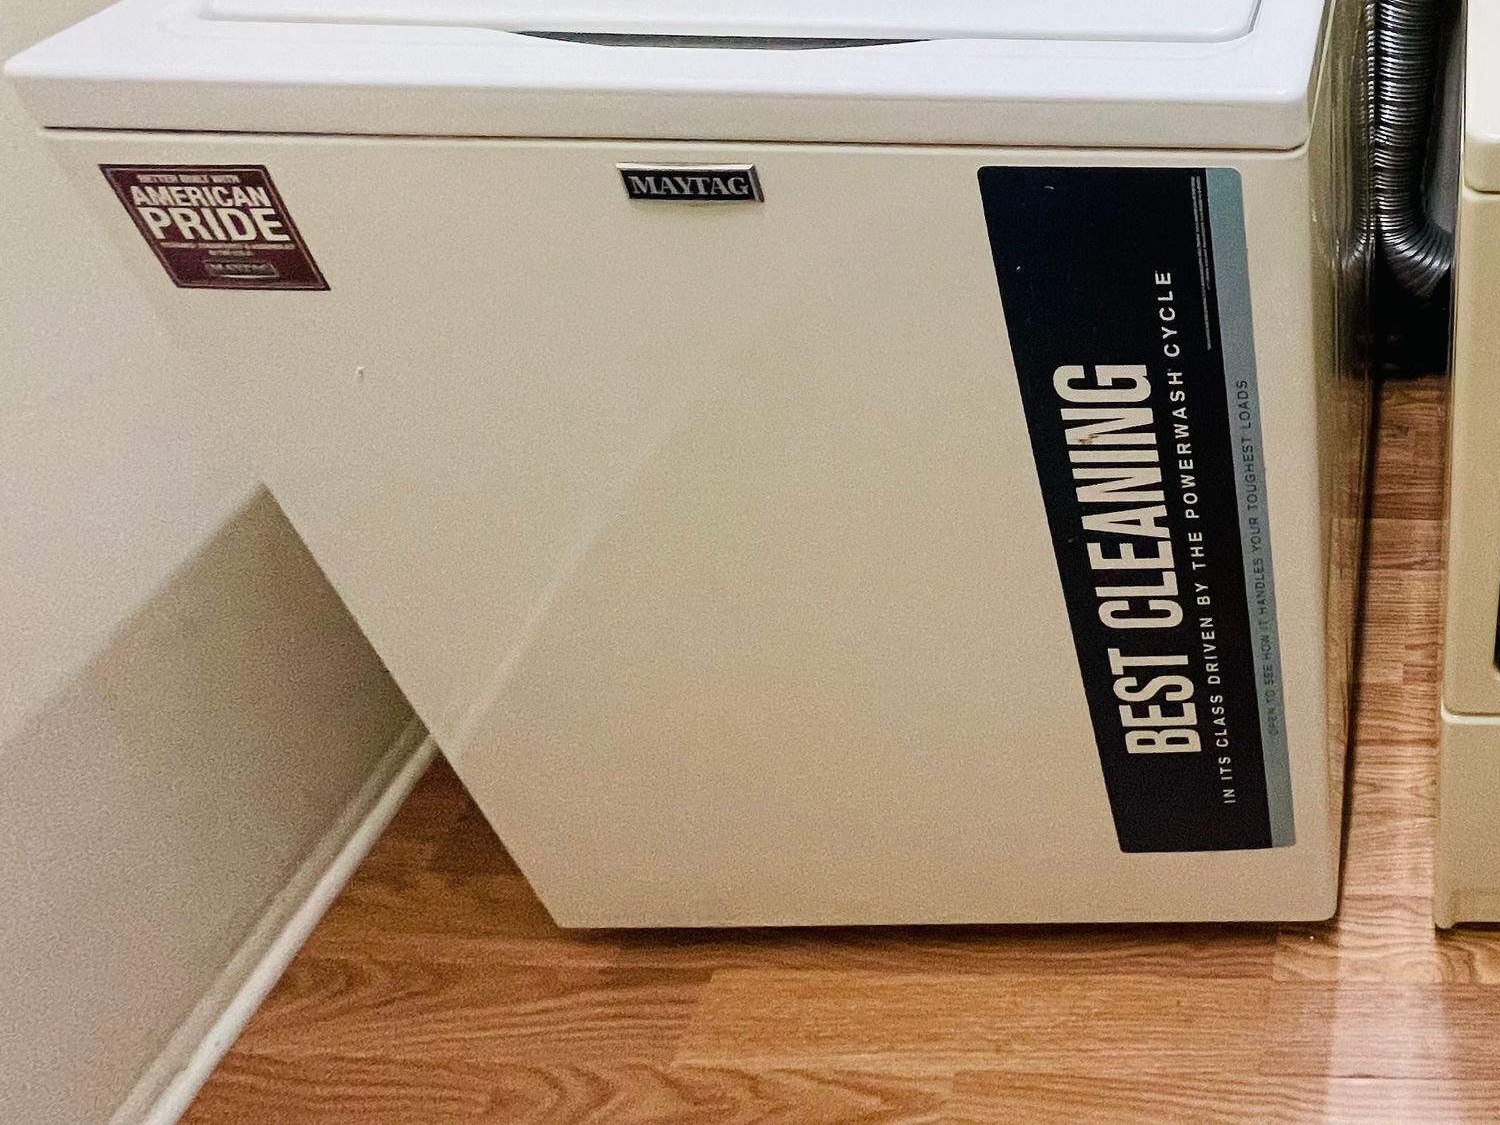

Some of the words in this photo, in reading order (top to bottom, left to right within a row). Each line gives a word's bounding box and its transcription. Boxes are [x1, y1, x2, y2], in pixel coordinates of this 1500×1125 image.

[130, 185, 272, 207] AMERICAN
[627, 175, 749, 195] MAYTAG
[137, 207, 292, 241] PRIDE
[1155, 271, 1181, 359] CYCLE
[1236, 379, 1252, 429] LOADS
[1241, 436, 1259, 510] TOUGHEST
[1053, 364, 1184, 629] CLEANING
[1187, 531, 1207, 571] THE
[1249, 516, 1262, 553] YOUR
[1195, 582, 1212, 606] BY
[1252, 557, 1267, 616] HANDLES
[1200, 616, 1221, 685] DRIVEN
[1260, 634, 1273, 661] HOW
[1263, 663, 1275, 685] SEE
[1107, 647, 1202, 754] BEST
[1265, 688, 1276, 704] TO
[1206, 693, 1230, 748] CLASS
[1216, 755, 1233, 782] ITS
[1223, 787, 1236, 804] IN
